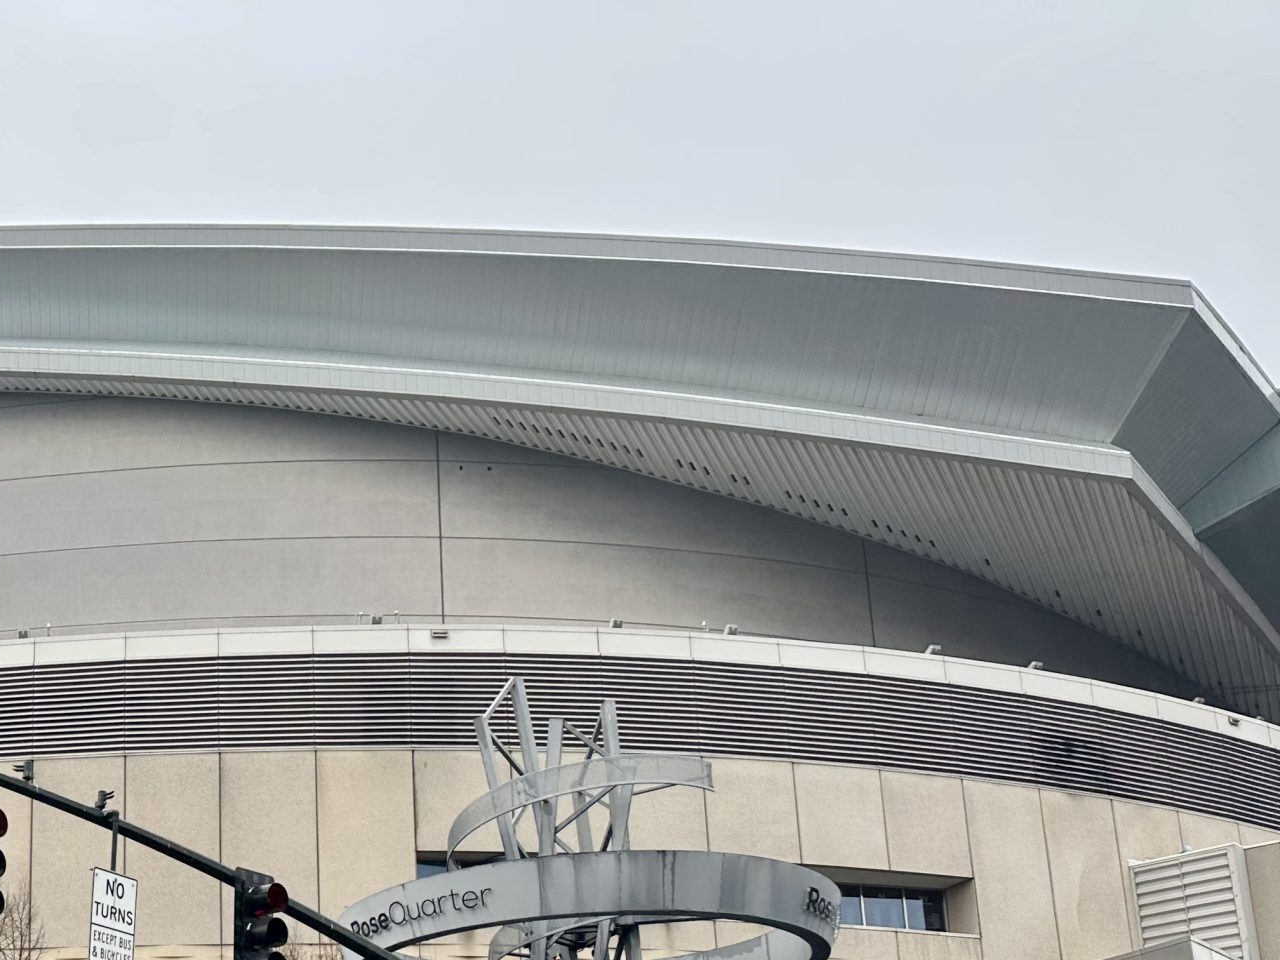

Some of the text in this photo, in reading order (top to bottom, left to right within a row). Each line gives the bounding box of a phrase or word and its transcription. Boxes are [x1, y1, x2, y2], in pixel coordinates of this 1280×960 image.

[105, 878, 125, 899] NO
[94, 900, 133, 926] TURNS
[93, 929, 132, 951] EXCEPT BUS
[92, 945, 98, 957] &
